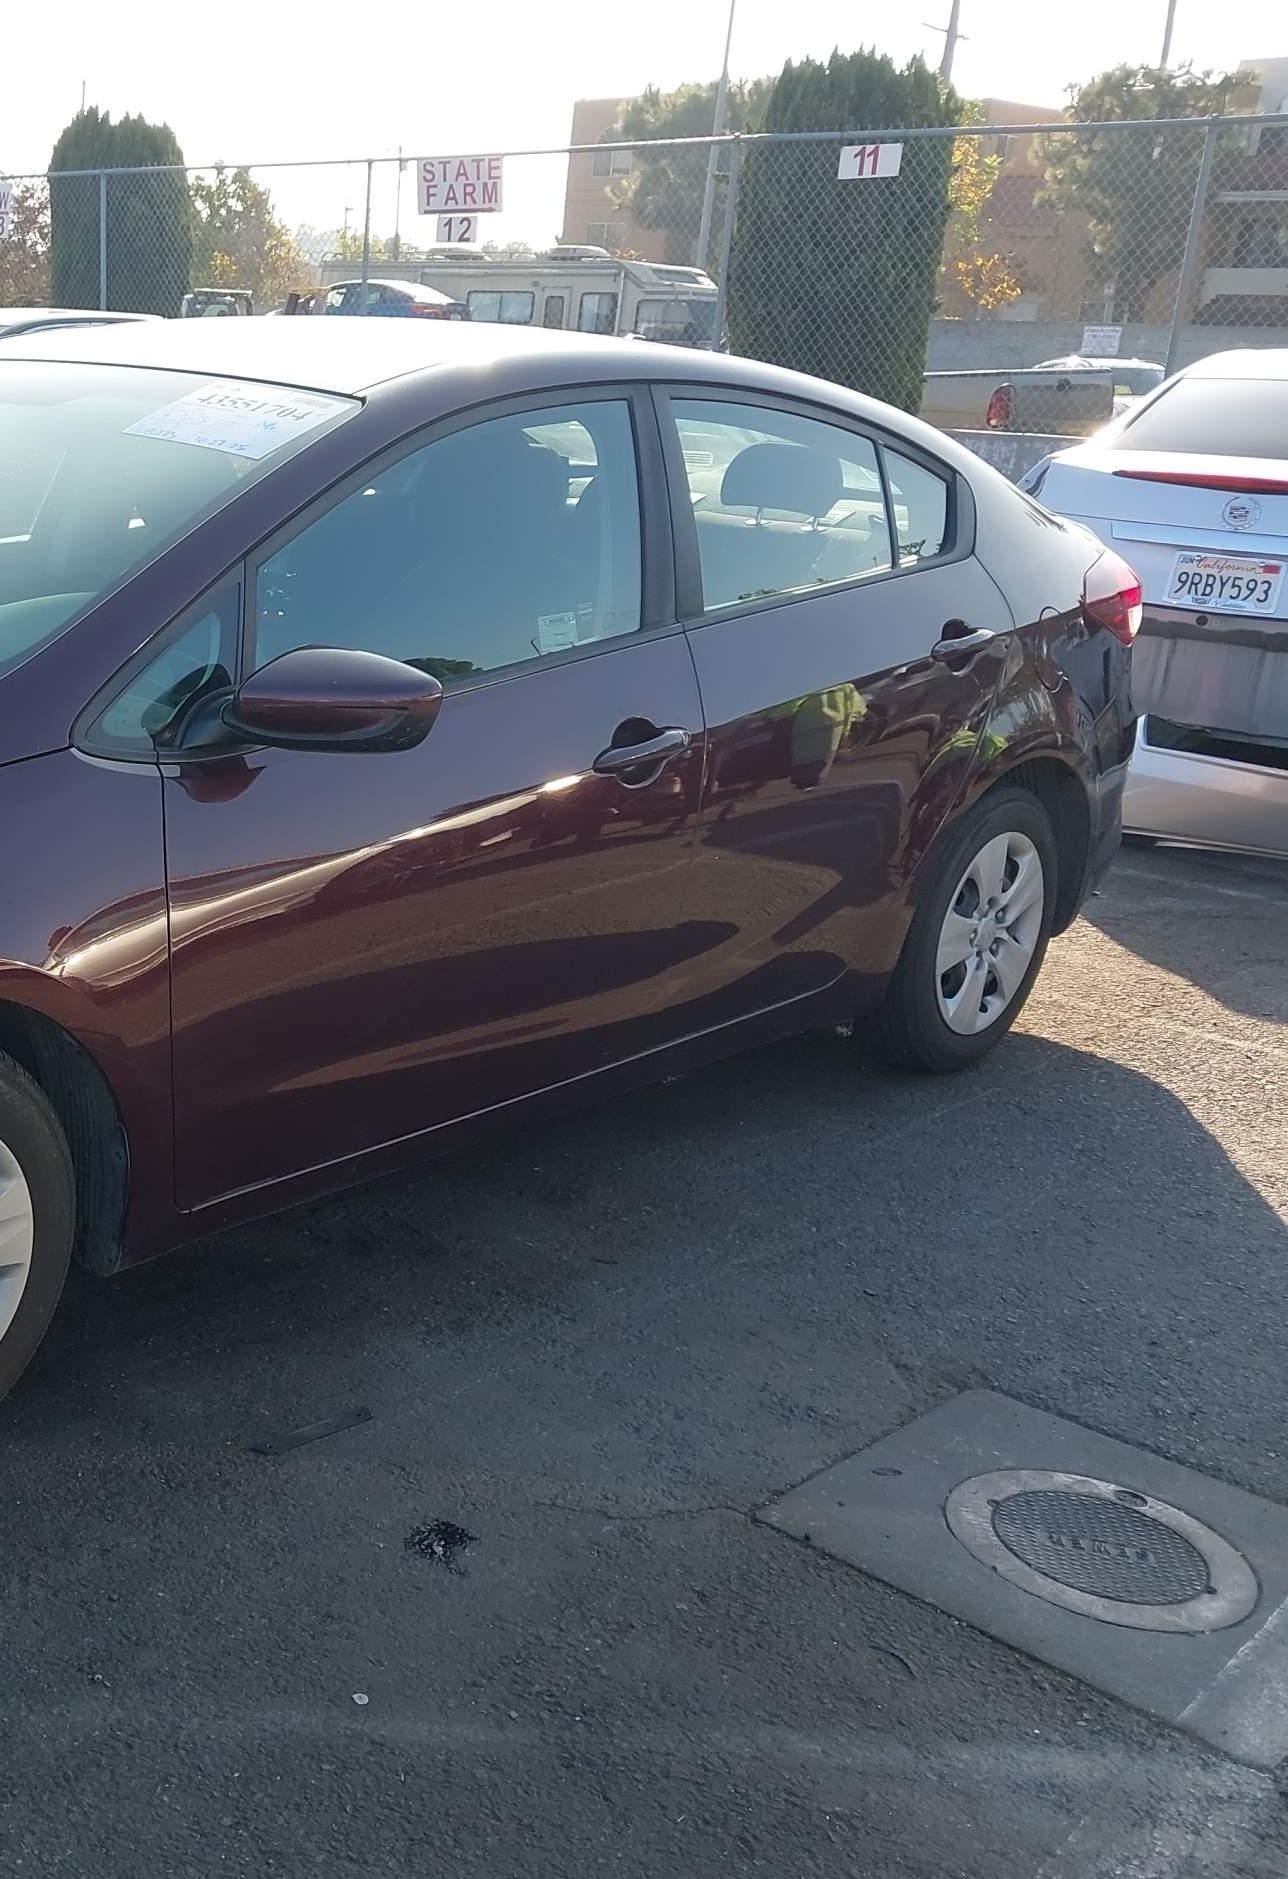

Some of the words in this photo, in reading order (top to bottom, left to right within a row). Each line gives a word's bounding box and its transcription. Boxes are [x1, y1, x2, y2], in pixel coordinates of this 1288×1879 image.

[422, 157, 502, 183] STATE
[853, 145, 881, 177] 11
[425, 181, 499, 207] FARM
[443, 216, 473, 242] 12
[198, 393, 313, 422] 43551704
[1196, 555, 1262, 574] California
[1174, 571, 1272, 602] 9RBY593
